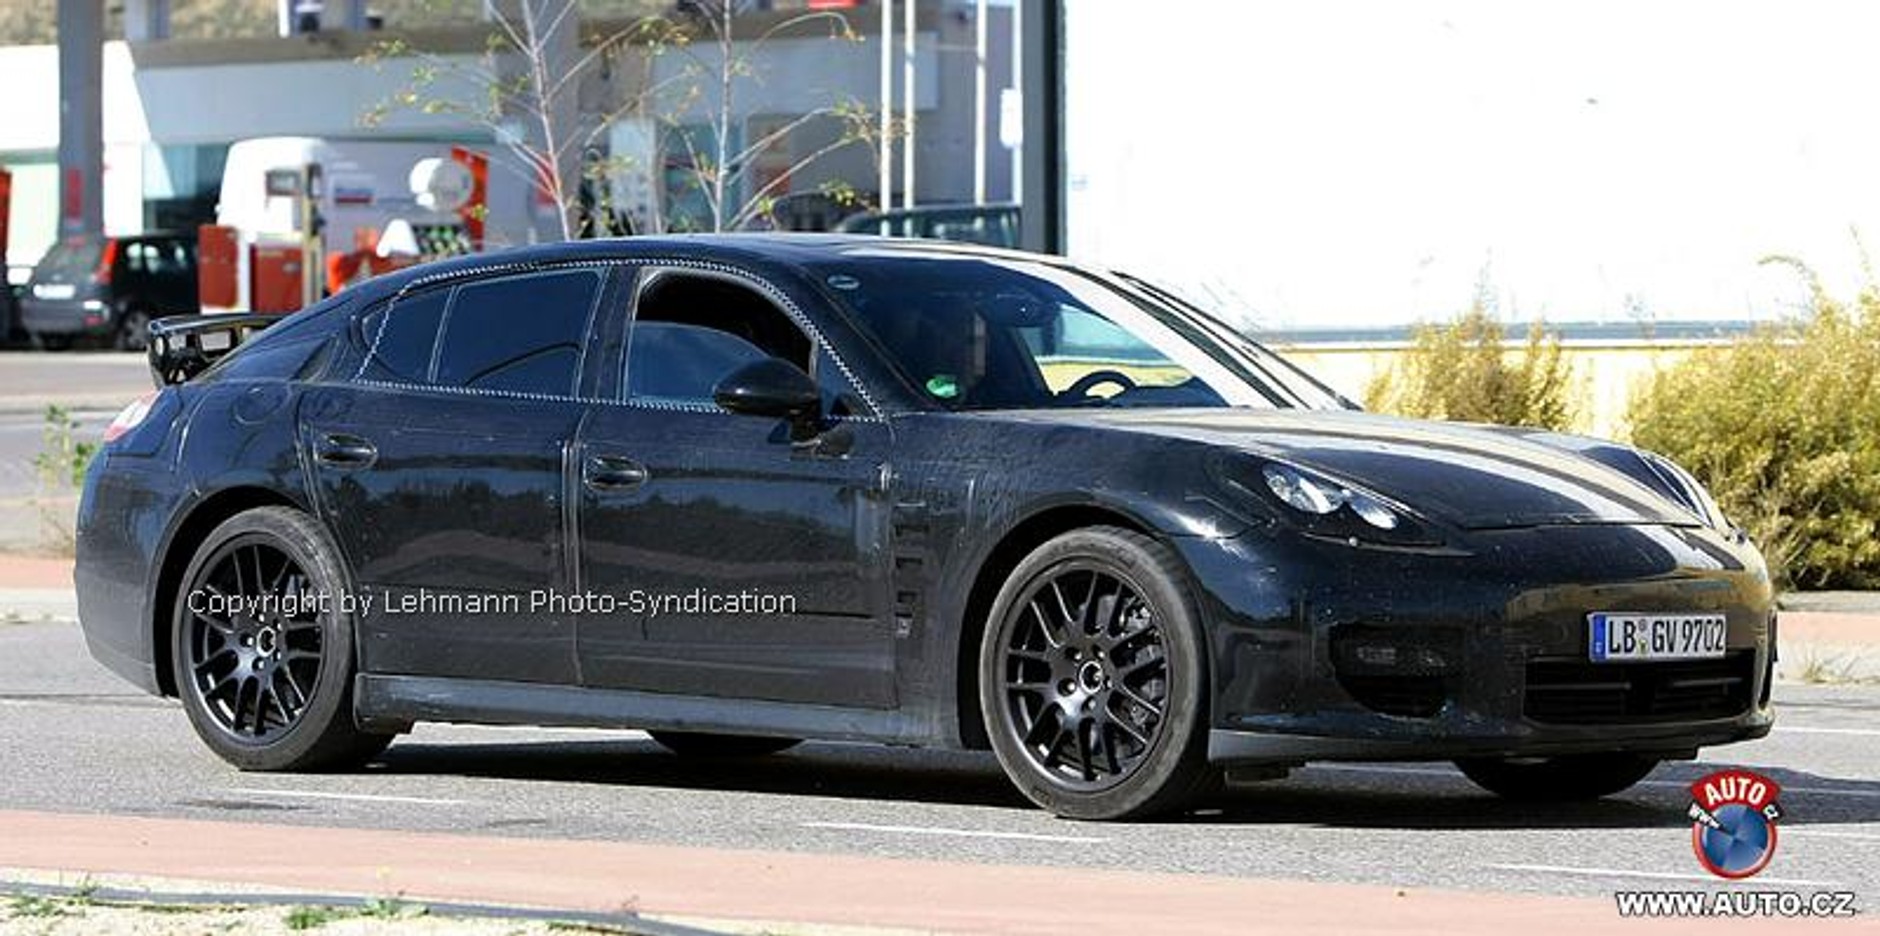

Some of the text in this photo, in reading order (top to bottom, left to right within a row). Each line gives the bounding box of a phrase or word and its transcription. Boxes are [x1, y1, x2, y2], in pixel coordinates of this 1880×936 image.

[1608, 618, 1725, 654] LB GV 9702
